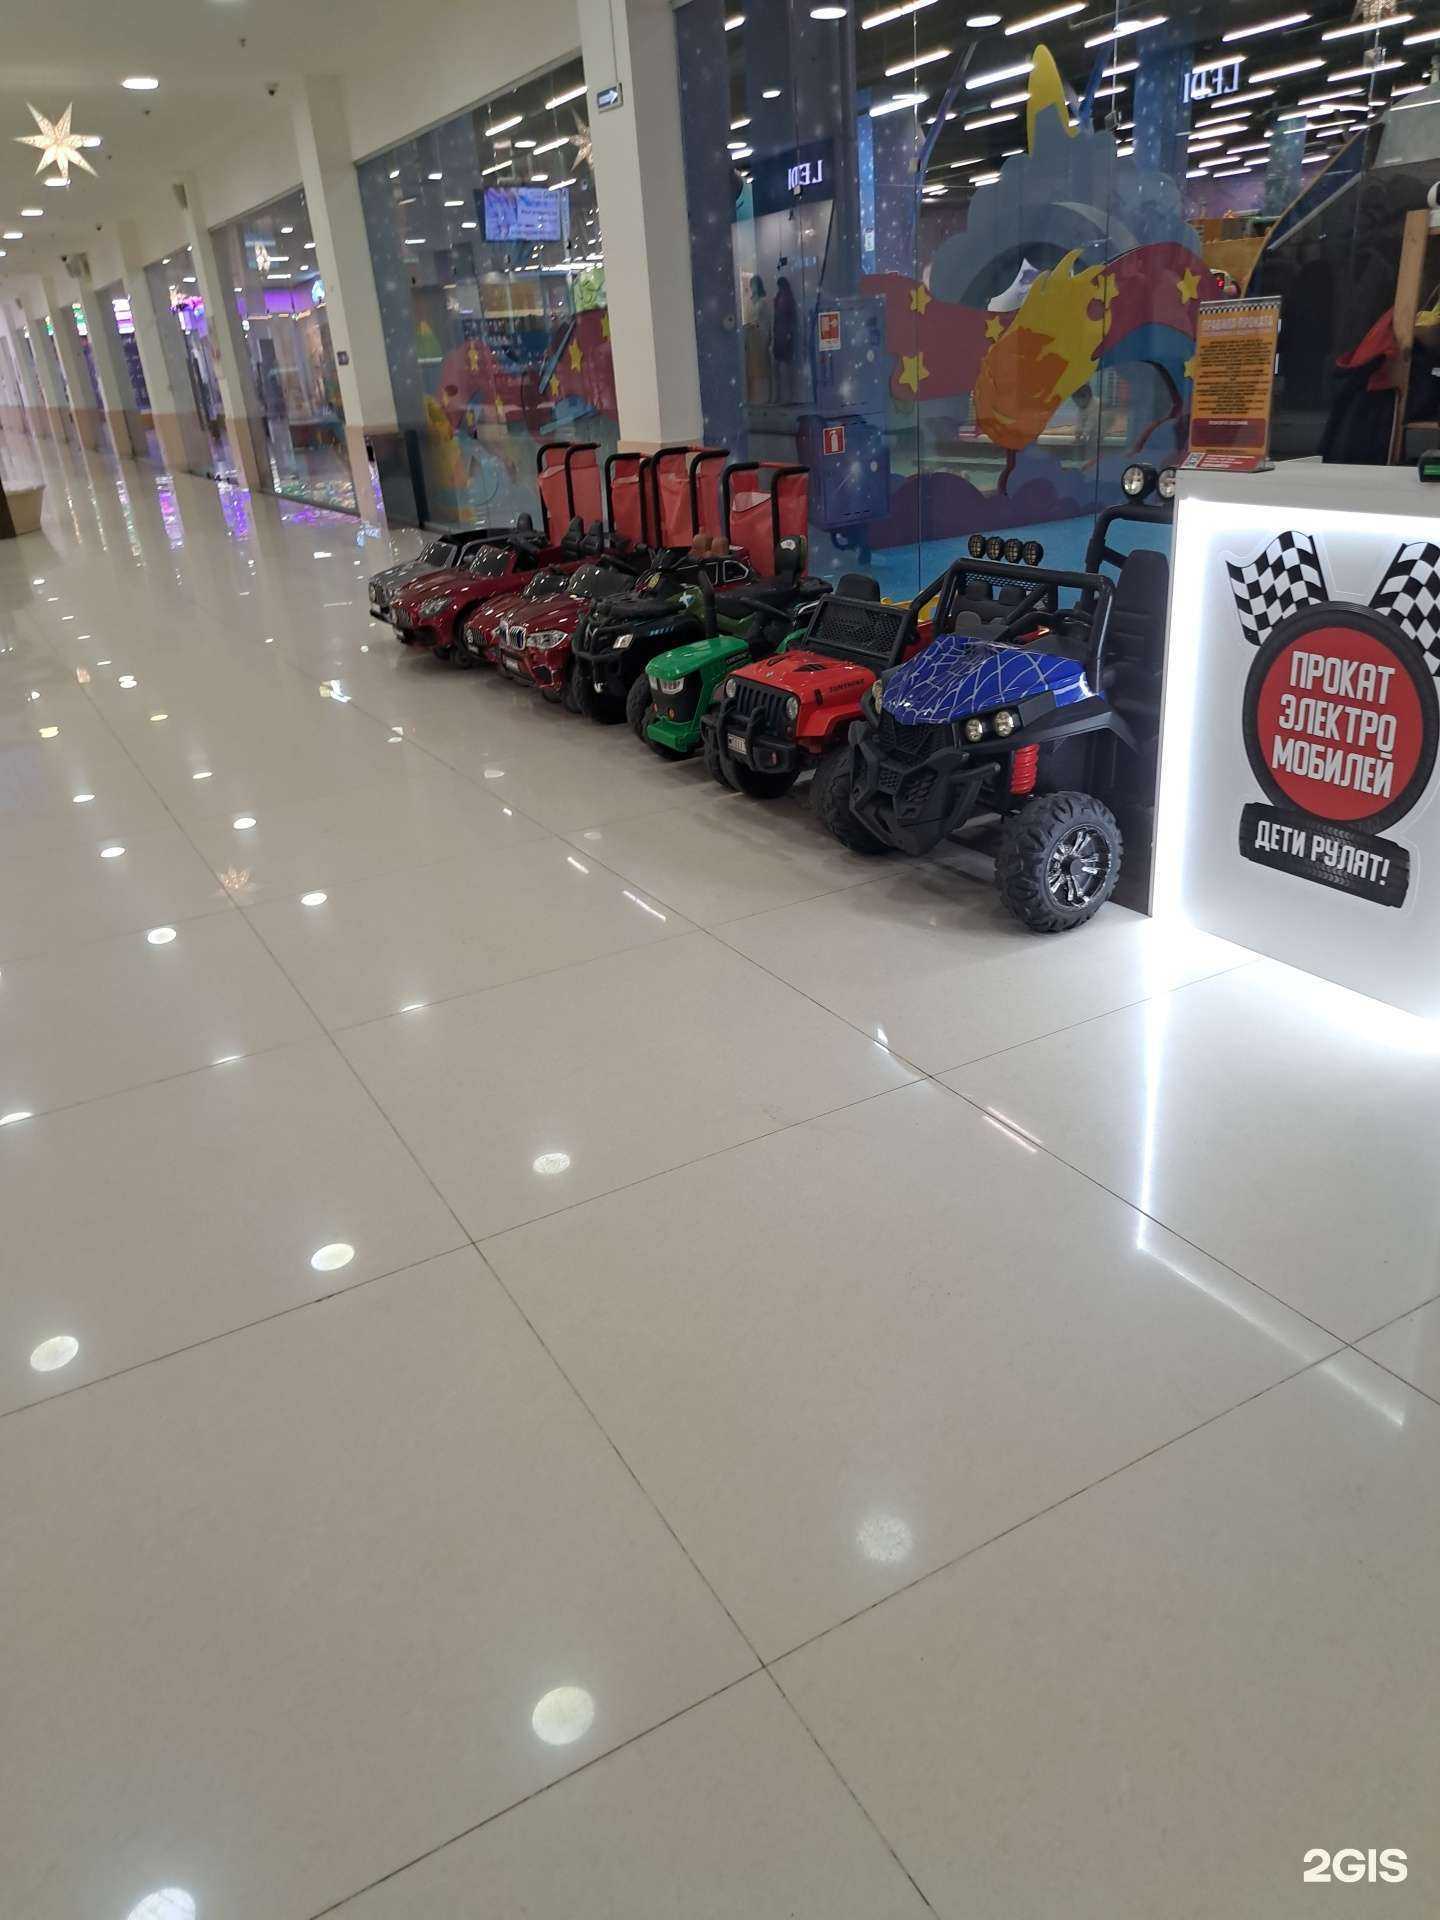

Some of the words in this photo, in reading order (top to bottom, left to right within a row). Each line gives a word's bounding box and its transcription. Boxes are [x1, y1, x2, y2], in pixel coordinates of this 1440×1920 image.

[1290, 651, 1395, 705] ПРОКАТ
[1278, 693, 1397, 752] ЭЛЕКТРО
[1271, 735, 1394, 798] МОБИЛЕЙ
[1254, 819, 1307, 858] ДЕТИ
[1310, 834, 1391, 886] РУЛЯТ!
